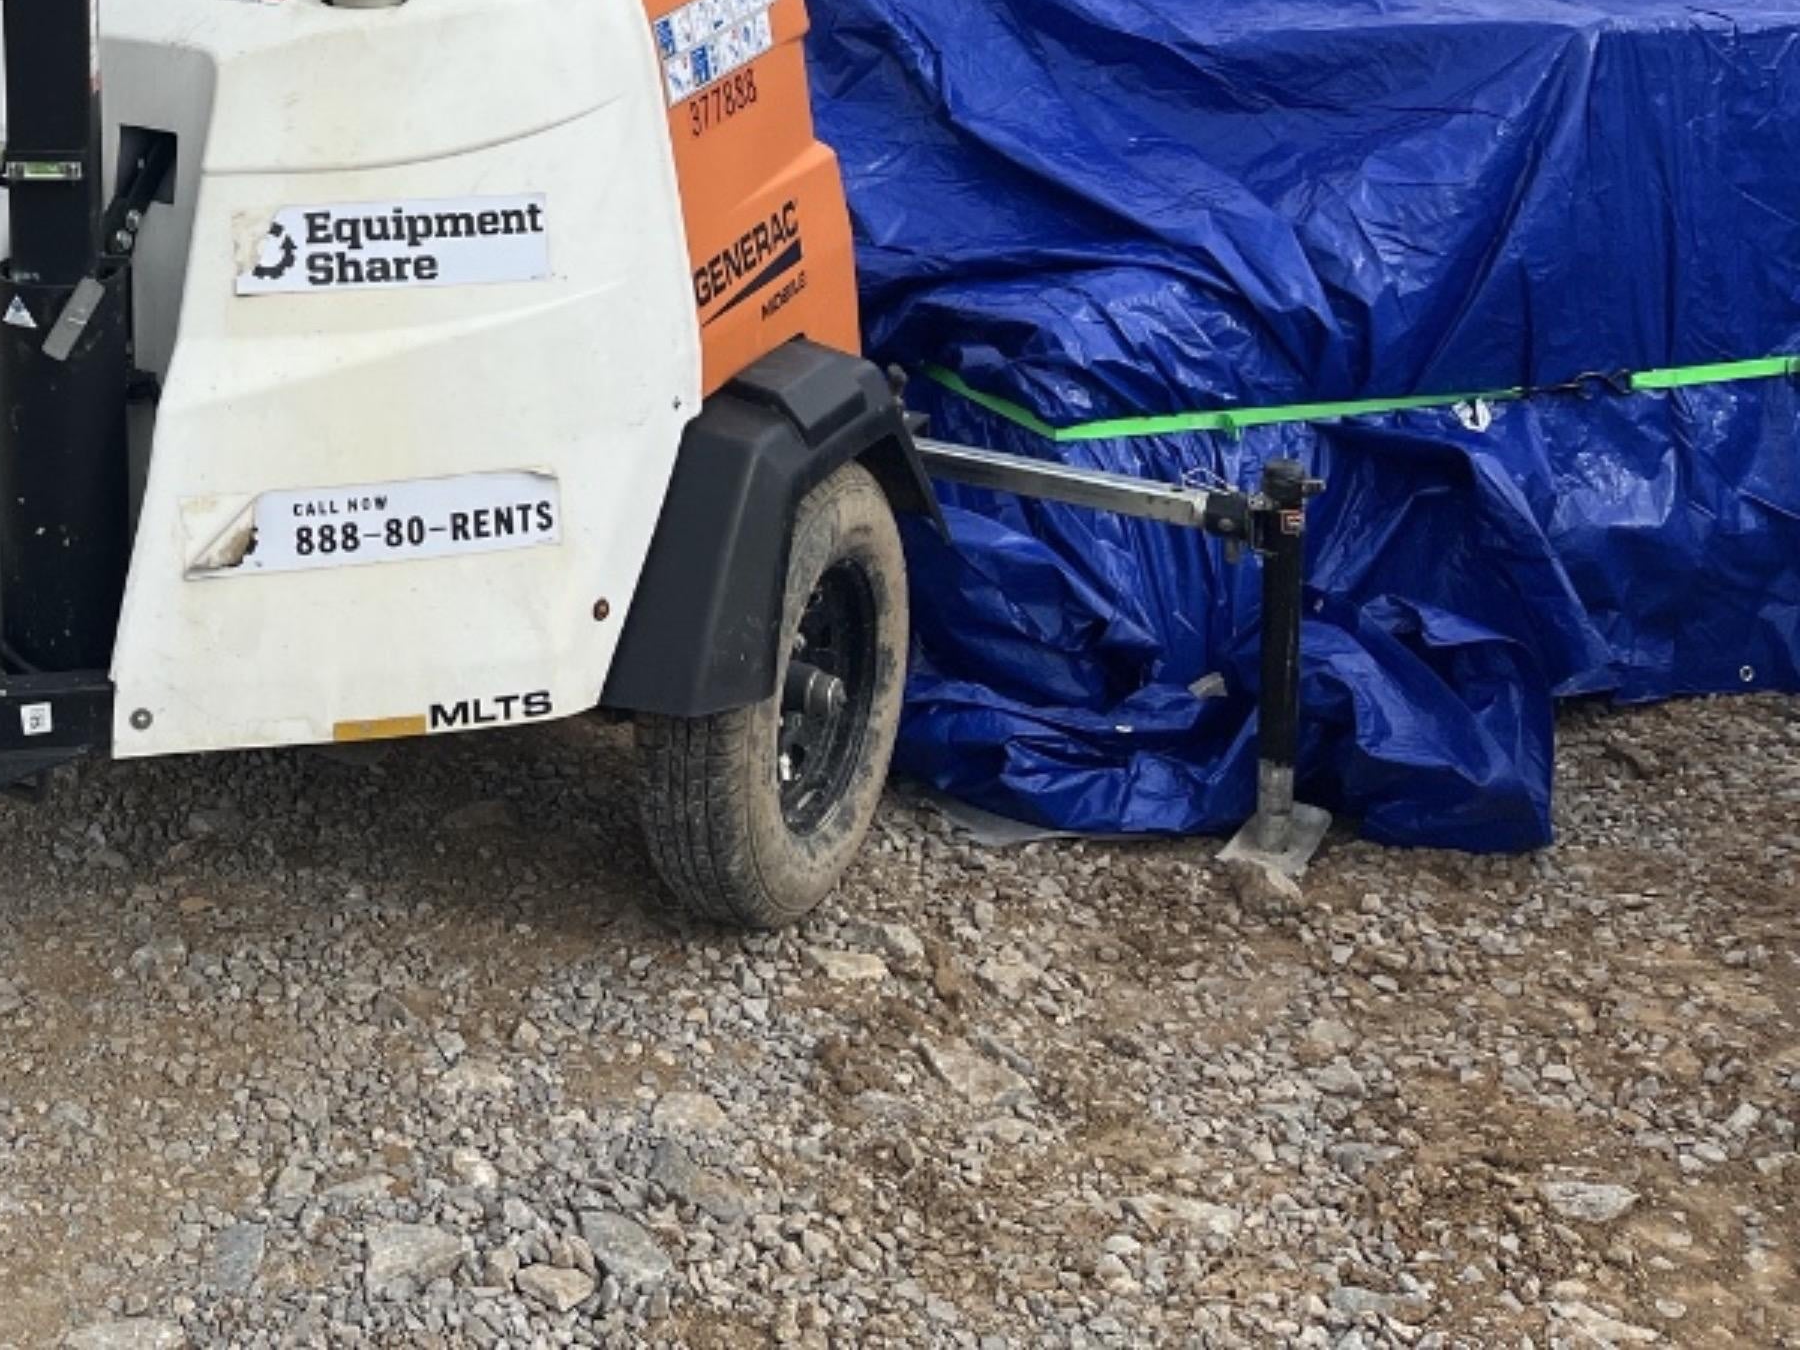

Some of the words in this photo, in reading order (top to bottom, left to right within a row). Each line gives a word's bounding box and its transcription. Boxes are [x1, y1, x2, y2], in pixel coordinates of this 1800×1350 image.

[689, 67, 758, 137] 377888
[303, 202, 545, 250] Equipment
[305, 250, 439, 286] Share
[693, 200, 799, 308] GENERAC
[292, 499, 339, 517] CALL
[346, 495, 388, 513] NOW
[295, 500, 554, 555] 888-80-RENTS
[429, 689, 553, 729] MLTS
